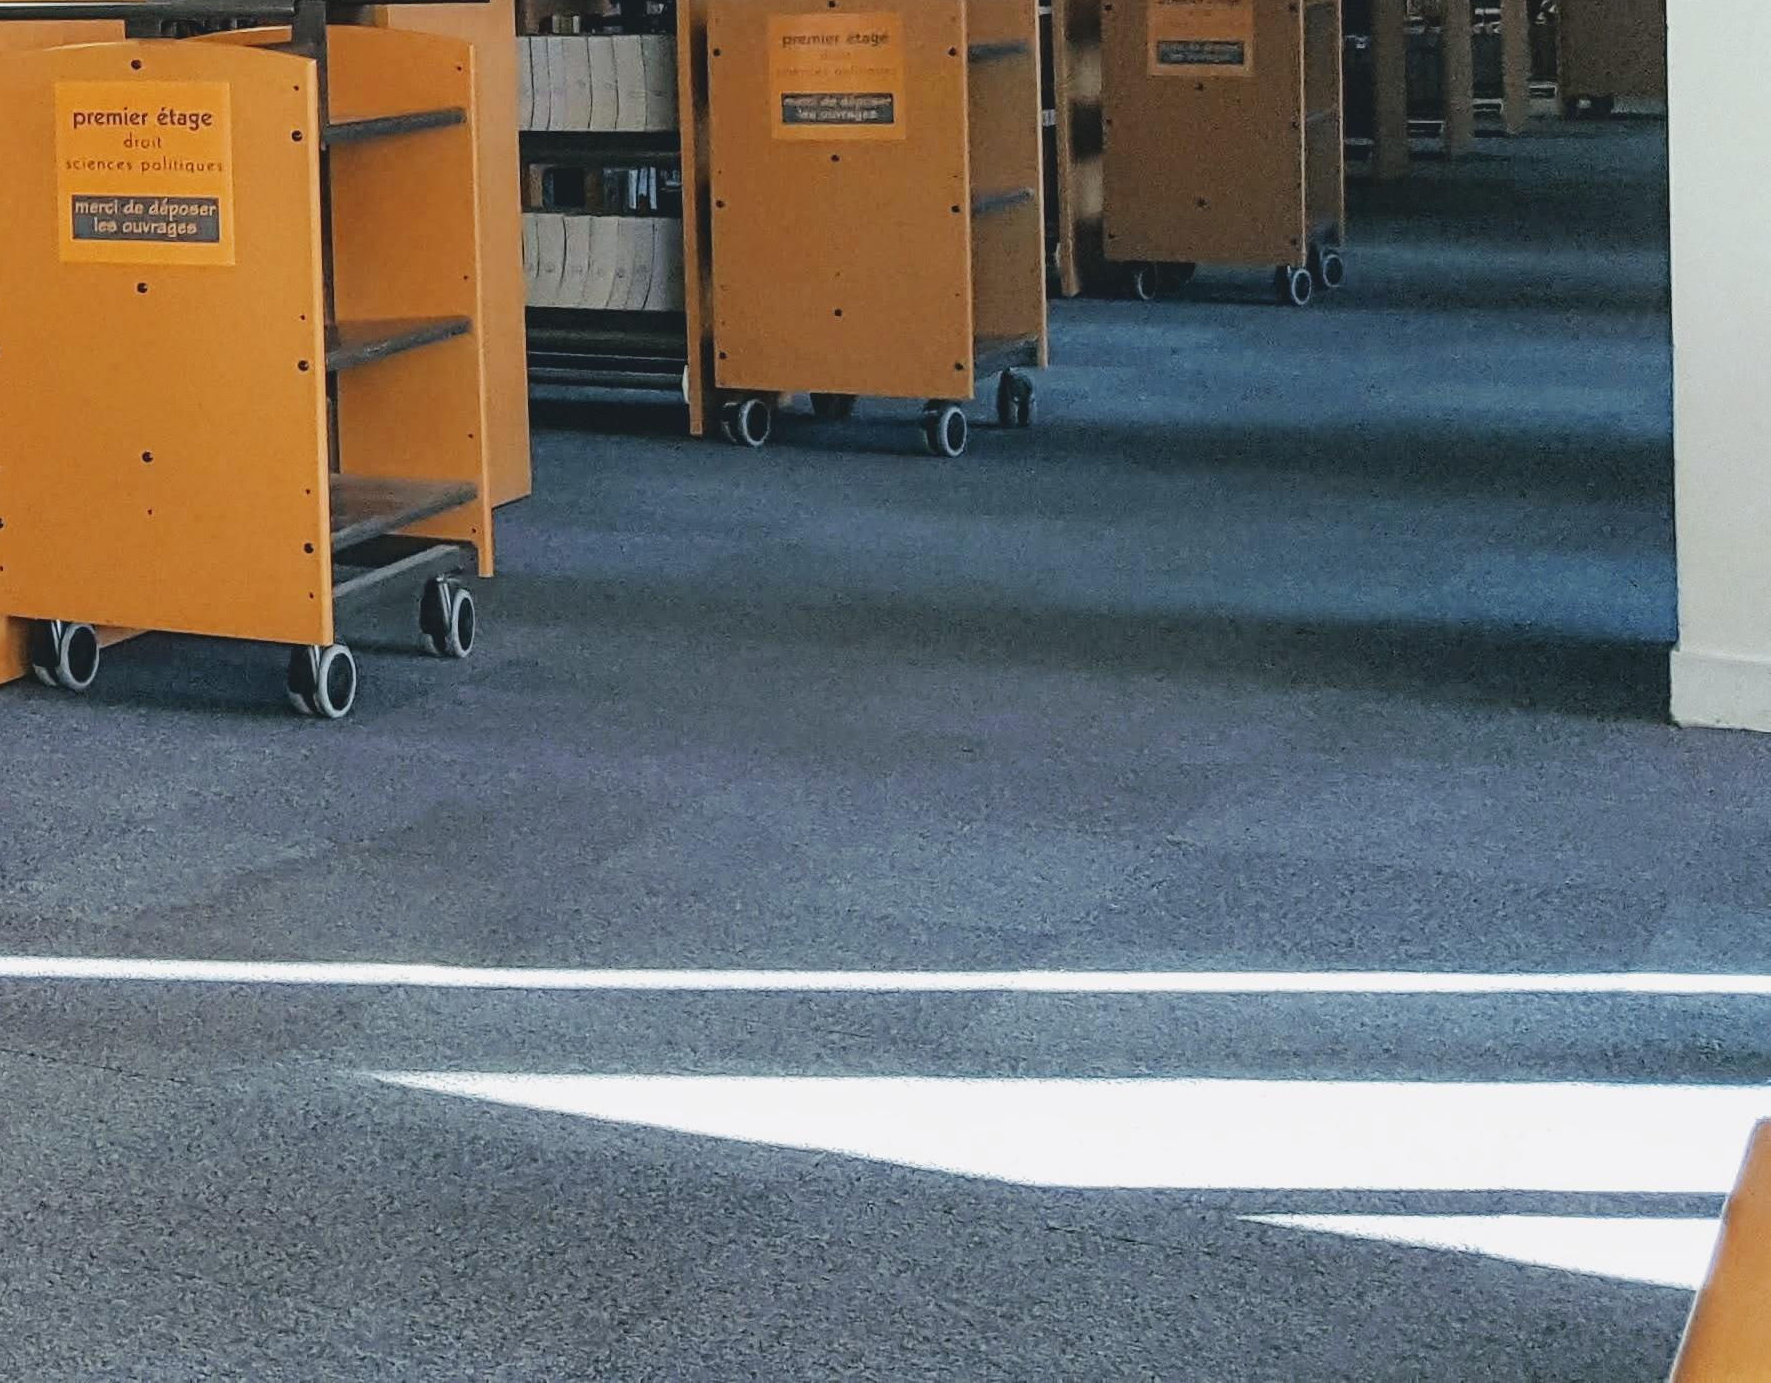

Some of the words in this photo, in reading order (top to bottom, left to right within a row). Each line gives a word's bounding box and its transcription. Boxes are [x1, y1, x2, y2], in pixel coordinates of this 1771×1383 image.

[782, 34, 838, 47] premier
[73, 106, 149, 129] premier
[157, 107, 213, 130] étage
[123, 132, 163, 149] droit
[66, 156, 133, 171] sciences
[141, 156, 223, 176] politiques
[75, 200, 118, 214] merci
[123, 200, 144, 214] de
[148, 198, 217, 221] déposer
[93, 217, 117, 233] les
[122, 221, 198, 238] ouvrages
